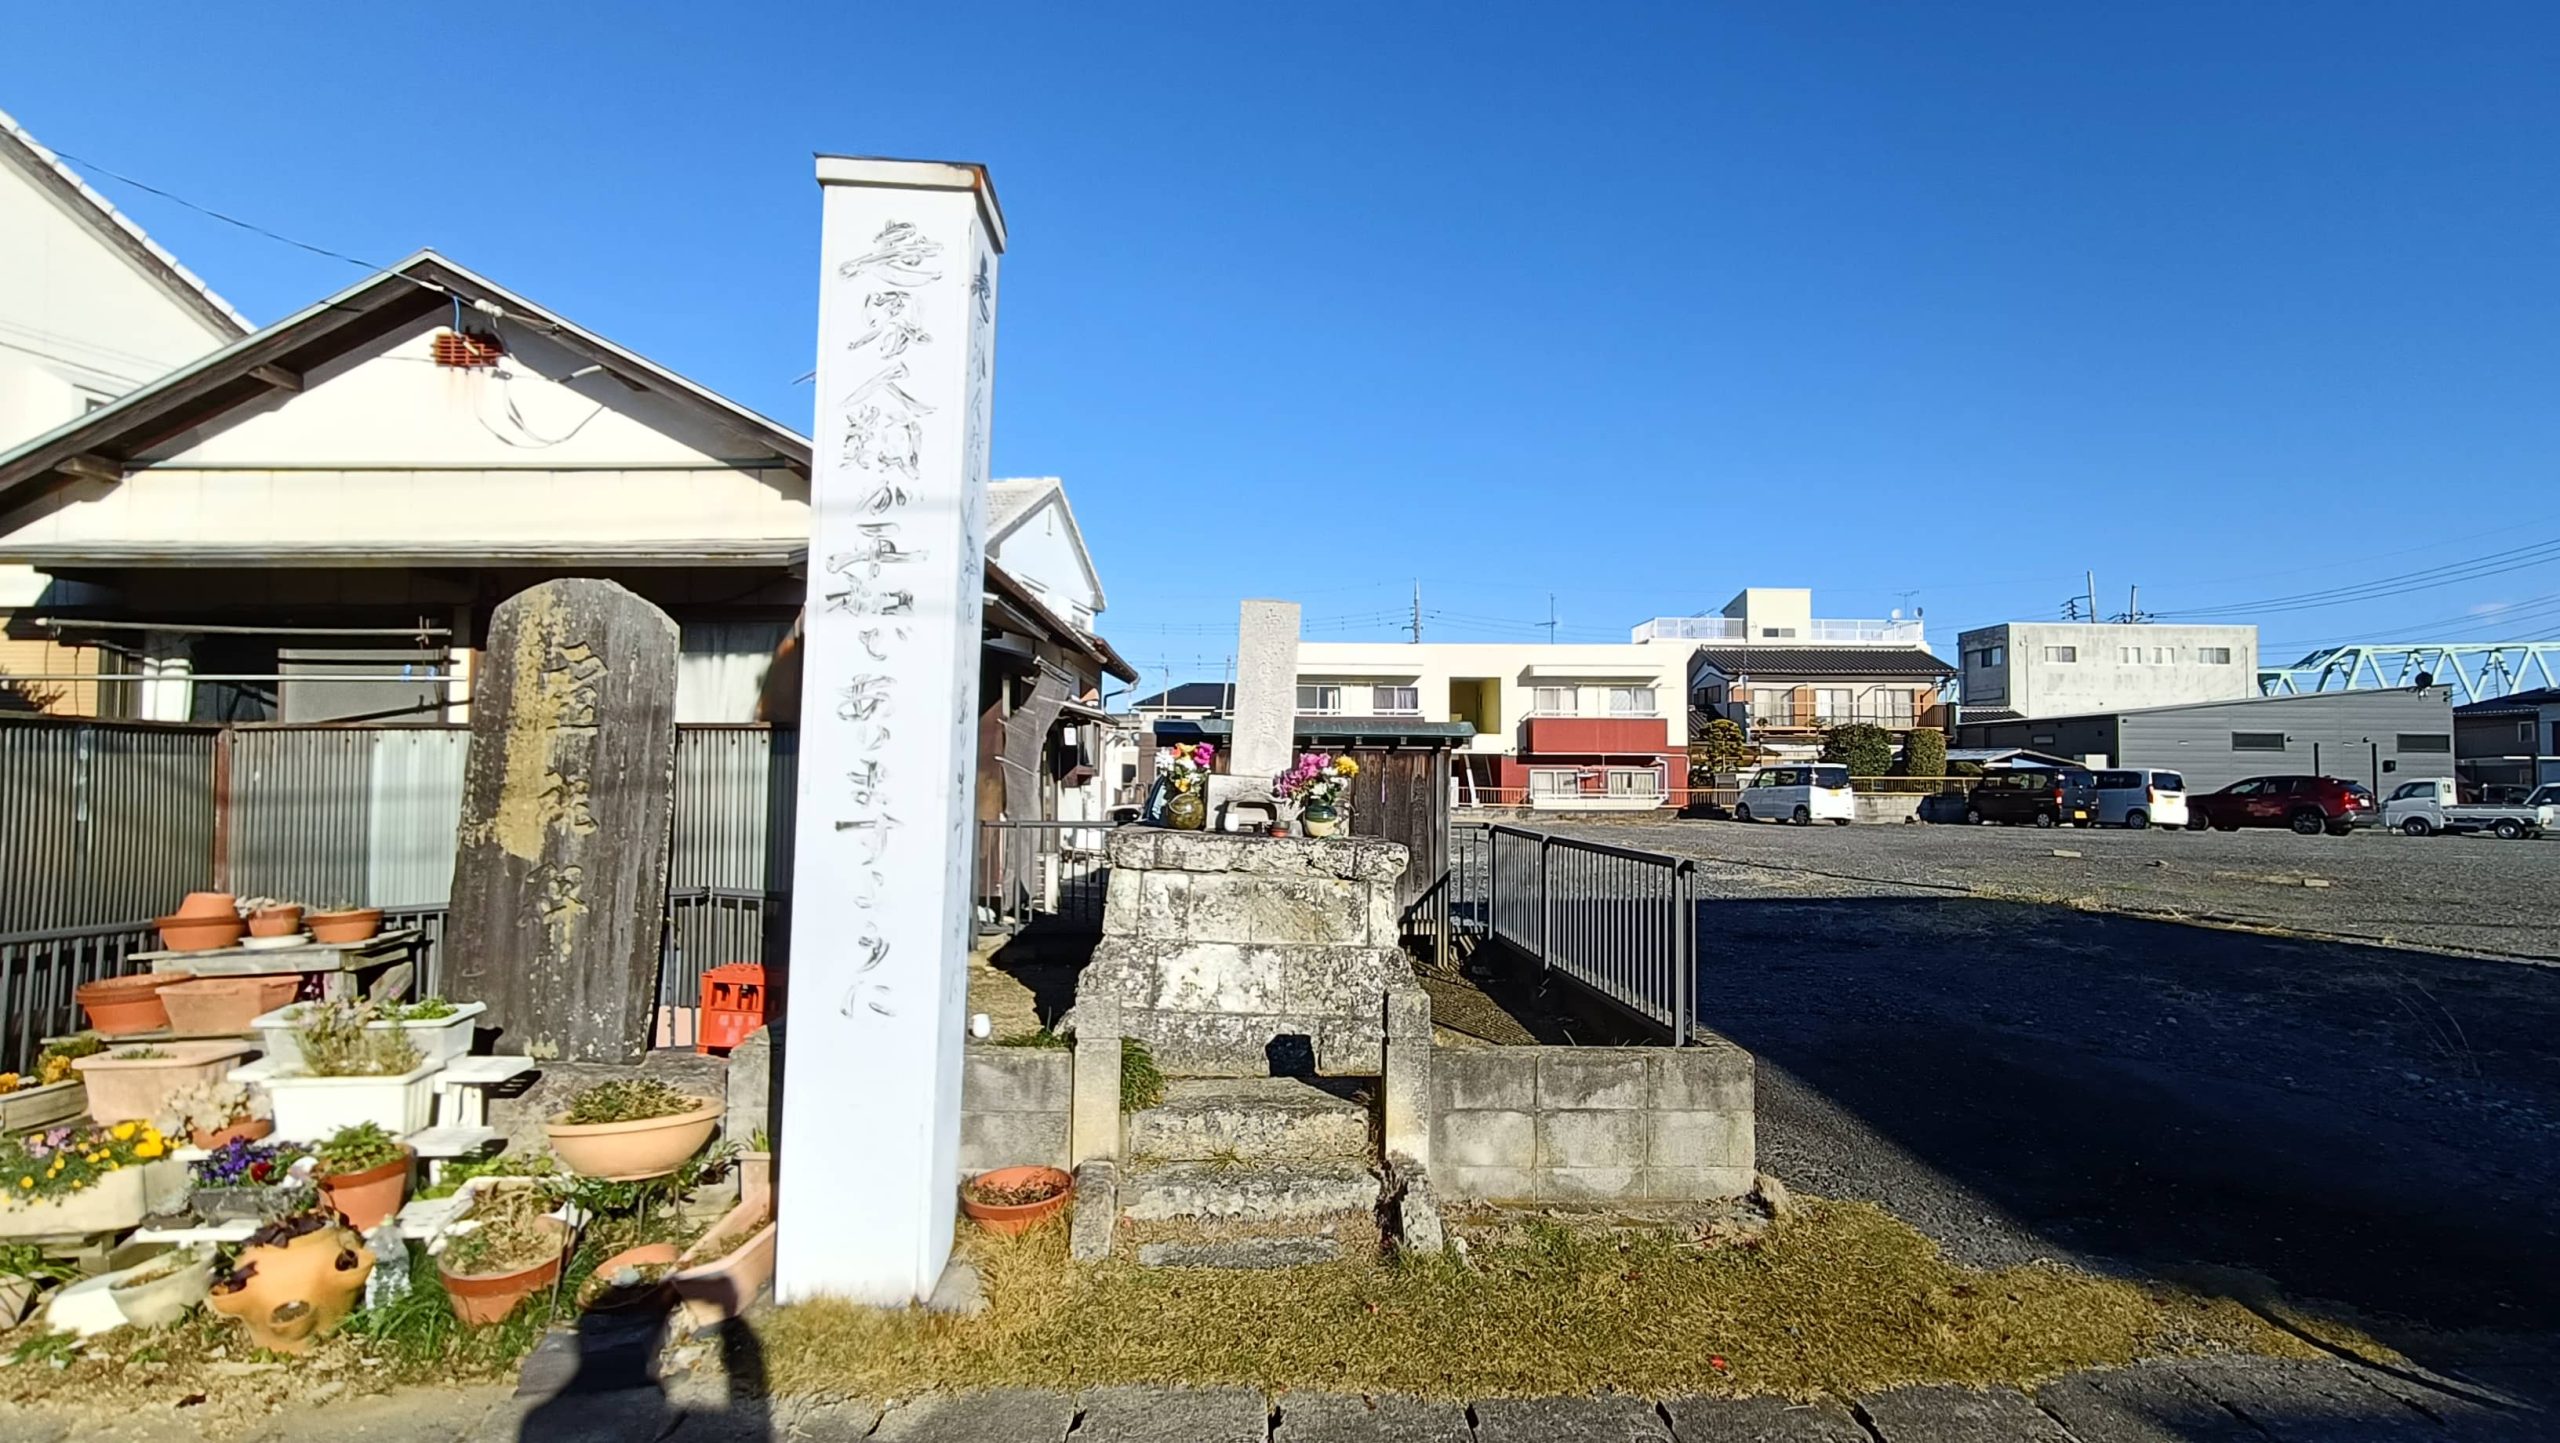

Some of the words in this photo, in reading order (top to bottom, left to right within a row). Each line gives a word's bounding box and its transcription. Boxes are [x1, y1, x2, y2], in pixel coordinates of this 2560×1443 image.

[826, 219, 944, 1018] 世界人類が平和でありますように
